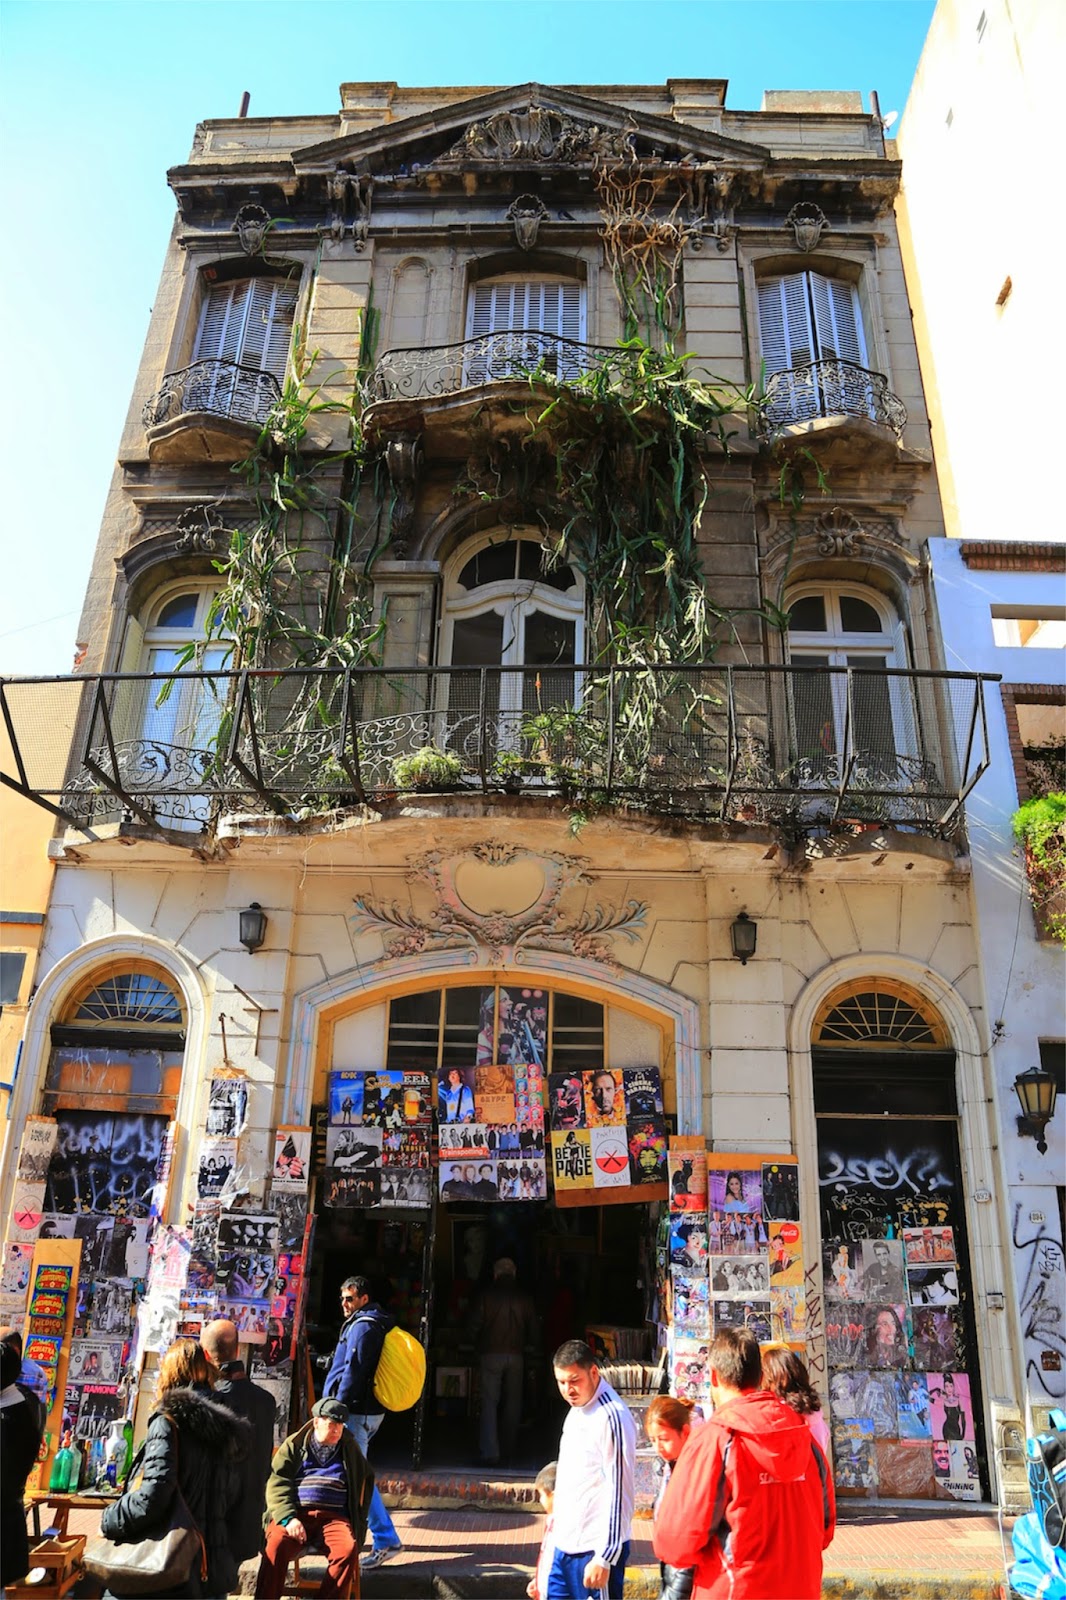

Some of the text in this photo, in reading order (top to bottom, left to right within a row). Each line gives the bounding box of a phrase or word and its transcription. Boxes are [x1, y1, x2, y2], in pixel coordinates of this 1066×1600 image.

[556, 1160, 592, 1177] PAGE
[976, 1192, 988, 1200] 892
[35, 1320, 61, 1328] MEDICO
[84, 1384, 119, 1395] RAMONE
